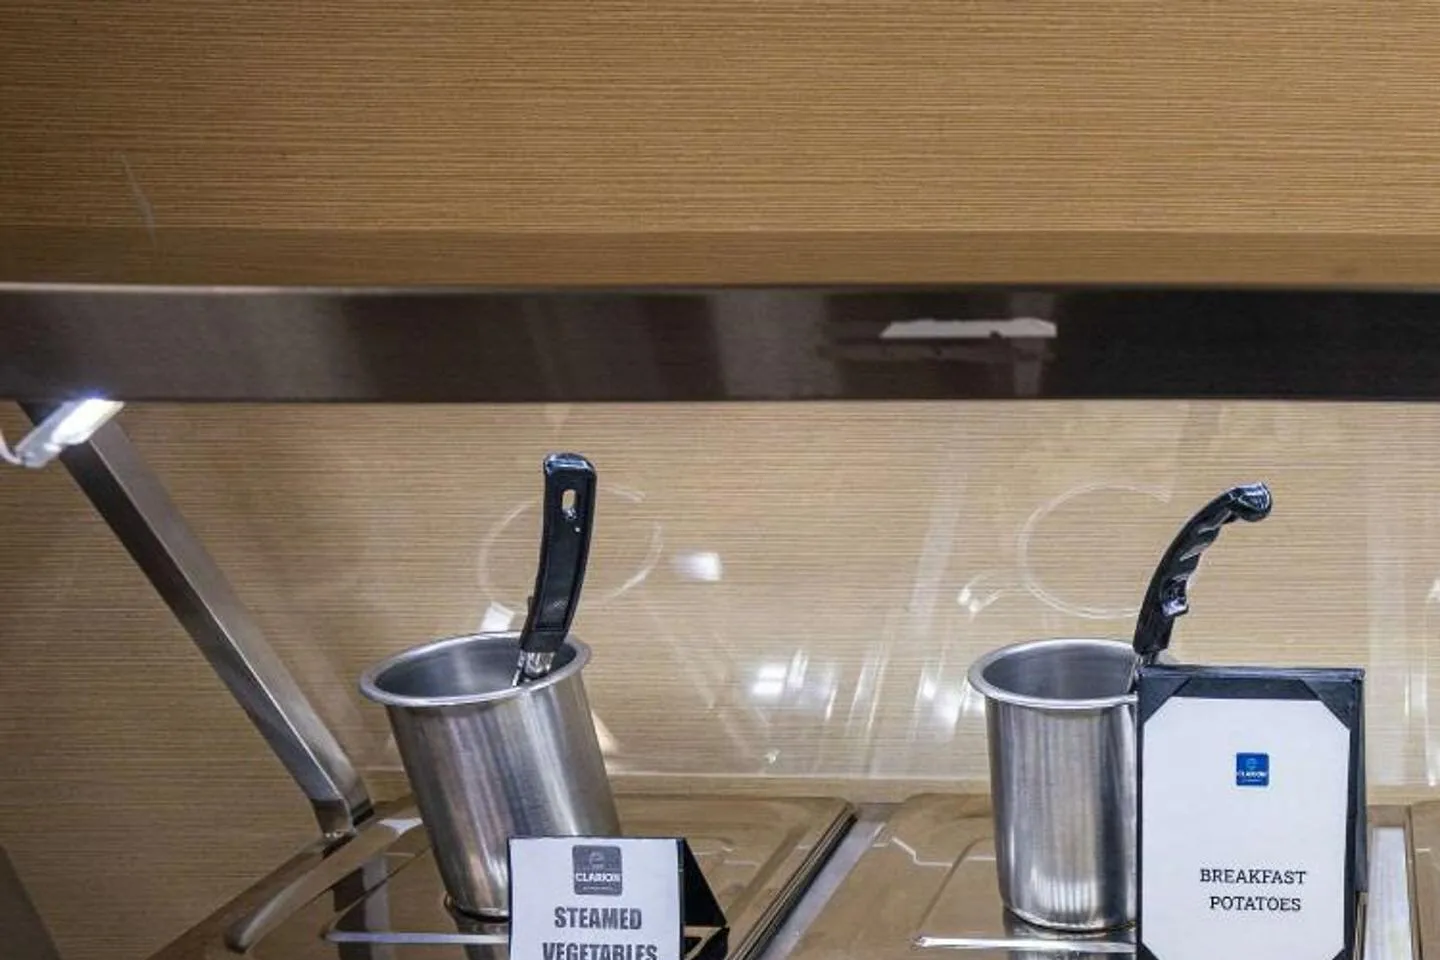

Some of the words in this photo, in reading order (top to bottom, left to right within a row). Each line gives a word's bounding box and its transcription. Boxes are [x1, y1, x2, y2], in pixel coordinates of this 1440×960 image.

[575, 872, 621, 883] CLARION
[1200, 868, 1307, 884] BREAKFAST
[1209, 895, 1302, 911] POTATOES
[554, 907, 643, 930] STEAMED
